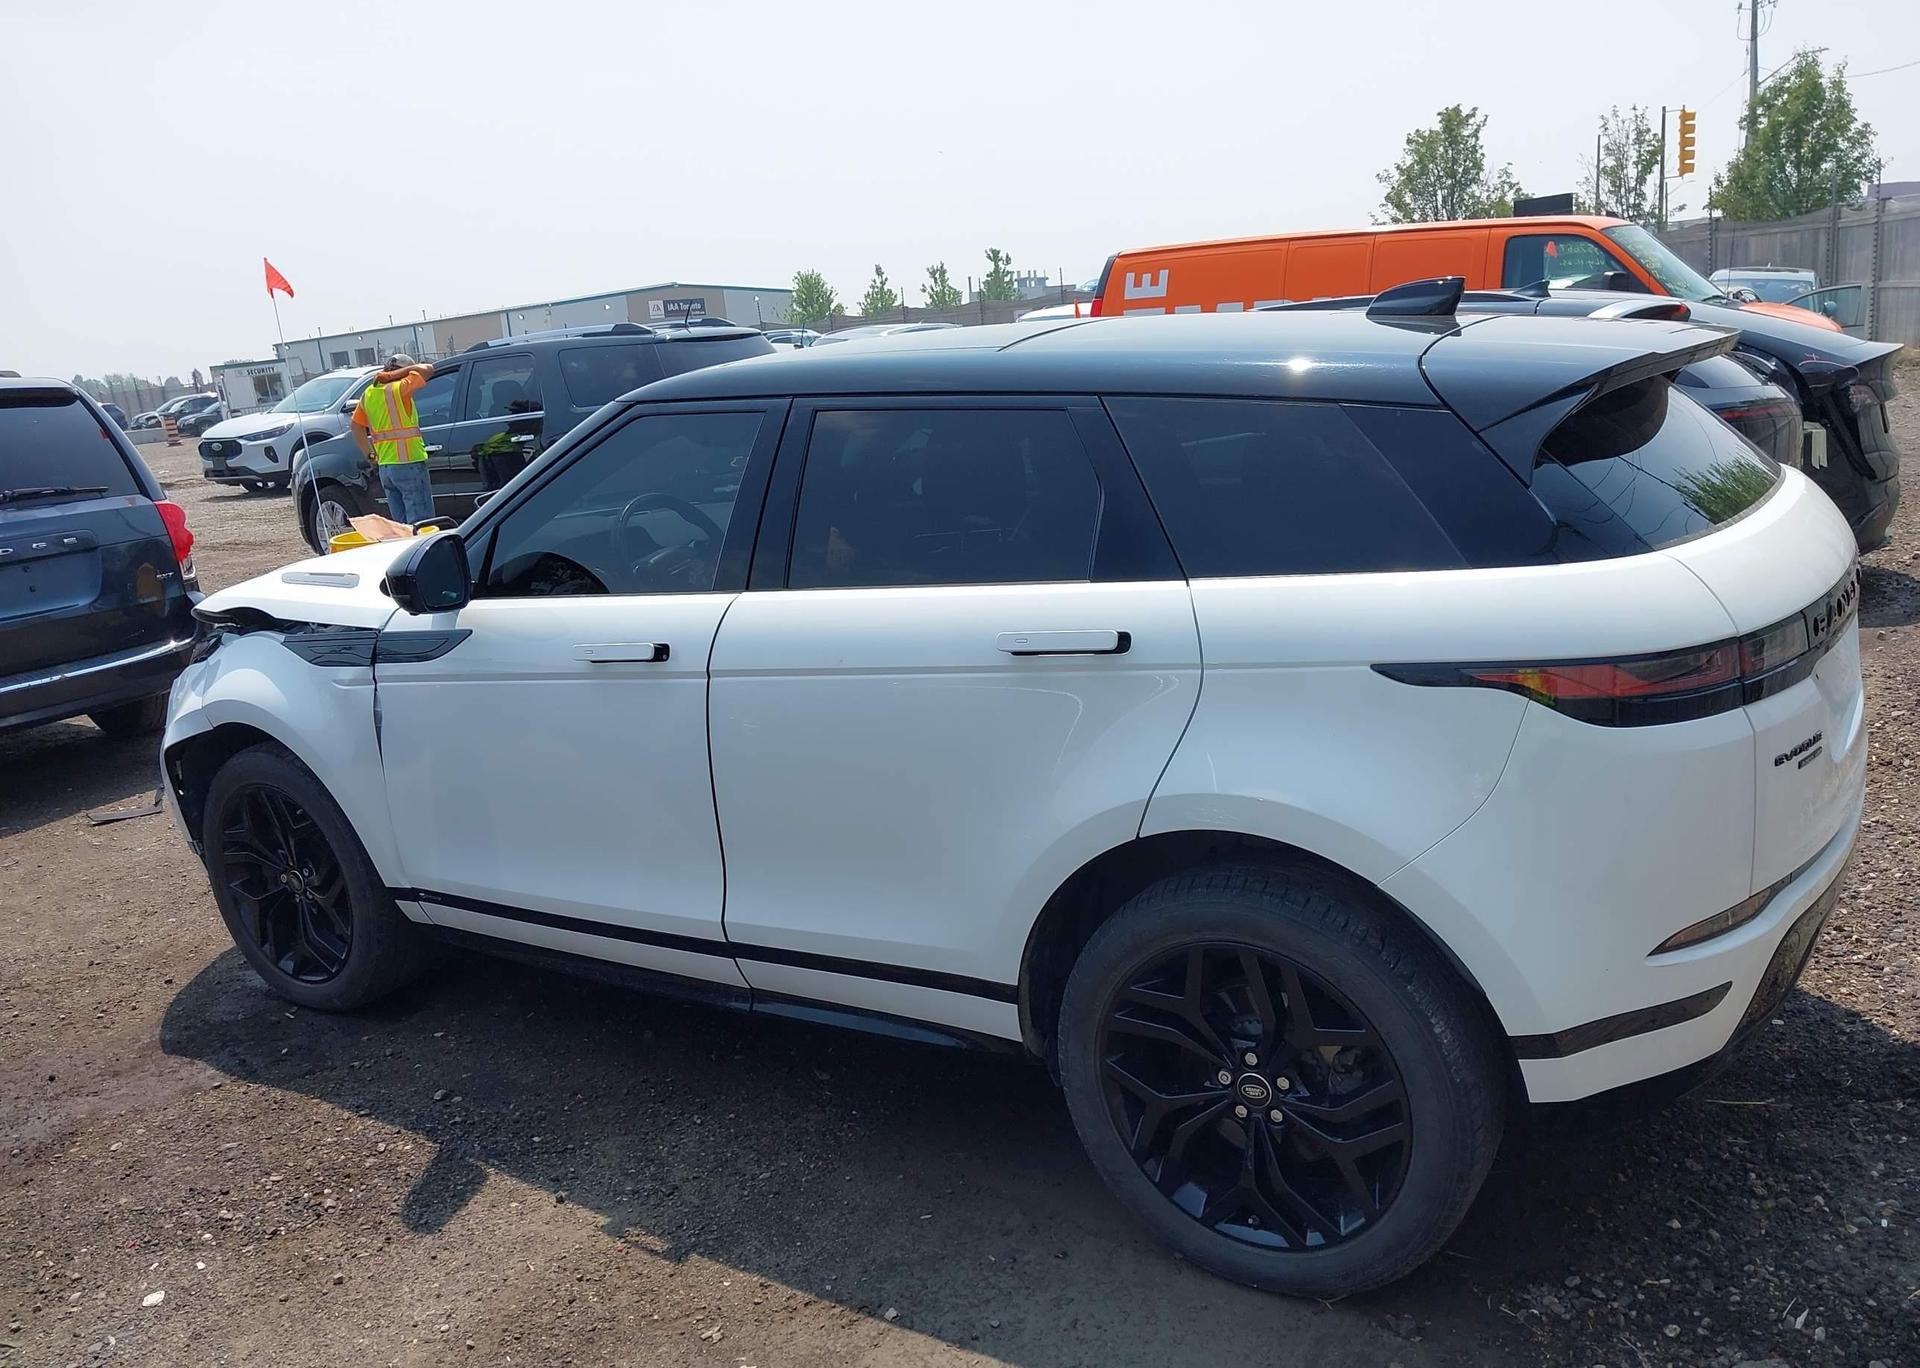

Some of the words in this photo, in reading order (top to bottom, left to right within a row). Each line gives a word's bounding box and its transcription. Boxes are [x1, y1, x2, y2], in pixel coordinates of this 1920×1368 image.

[667, 303, 679, 311] IAA
[247, 367, 275, 375] SECURITY
[1774, 729, 1823, 767] EVOQUE
